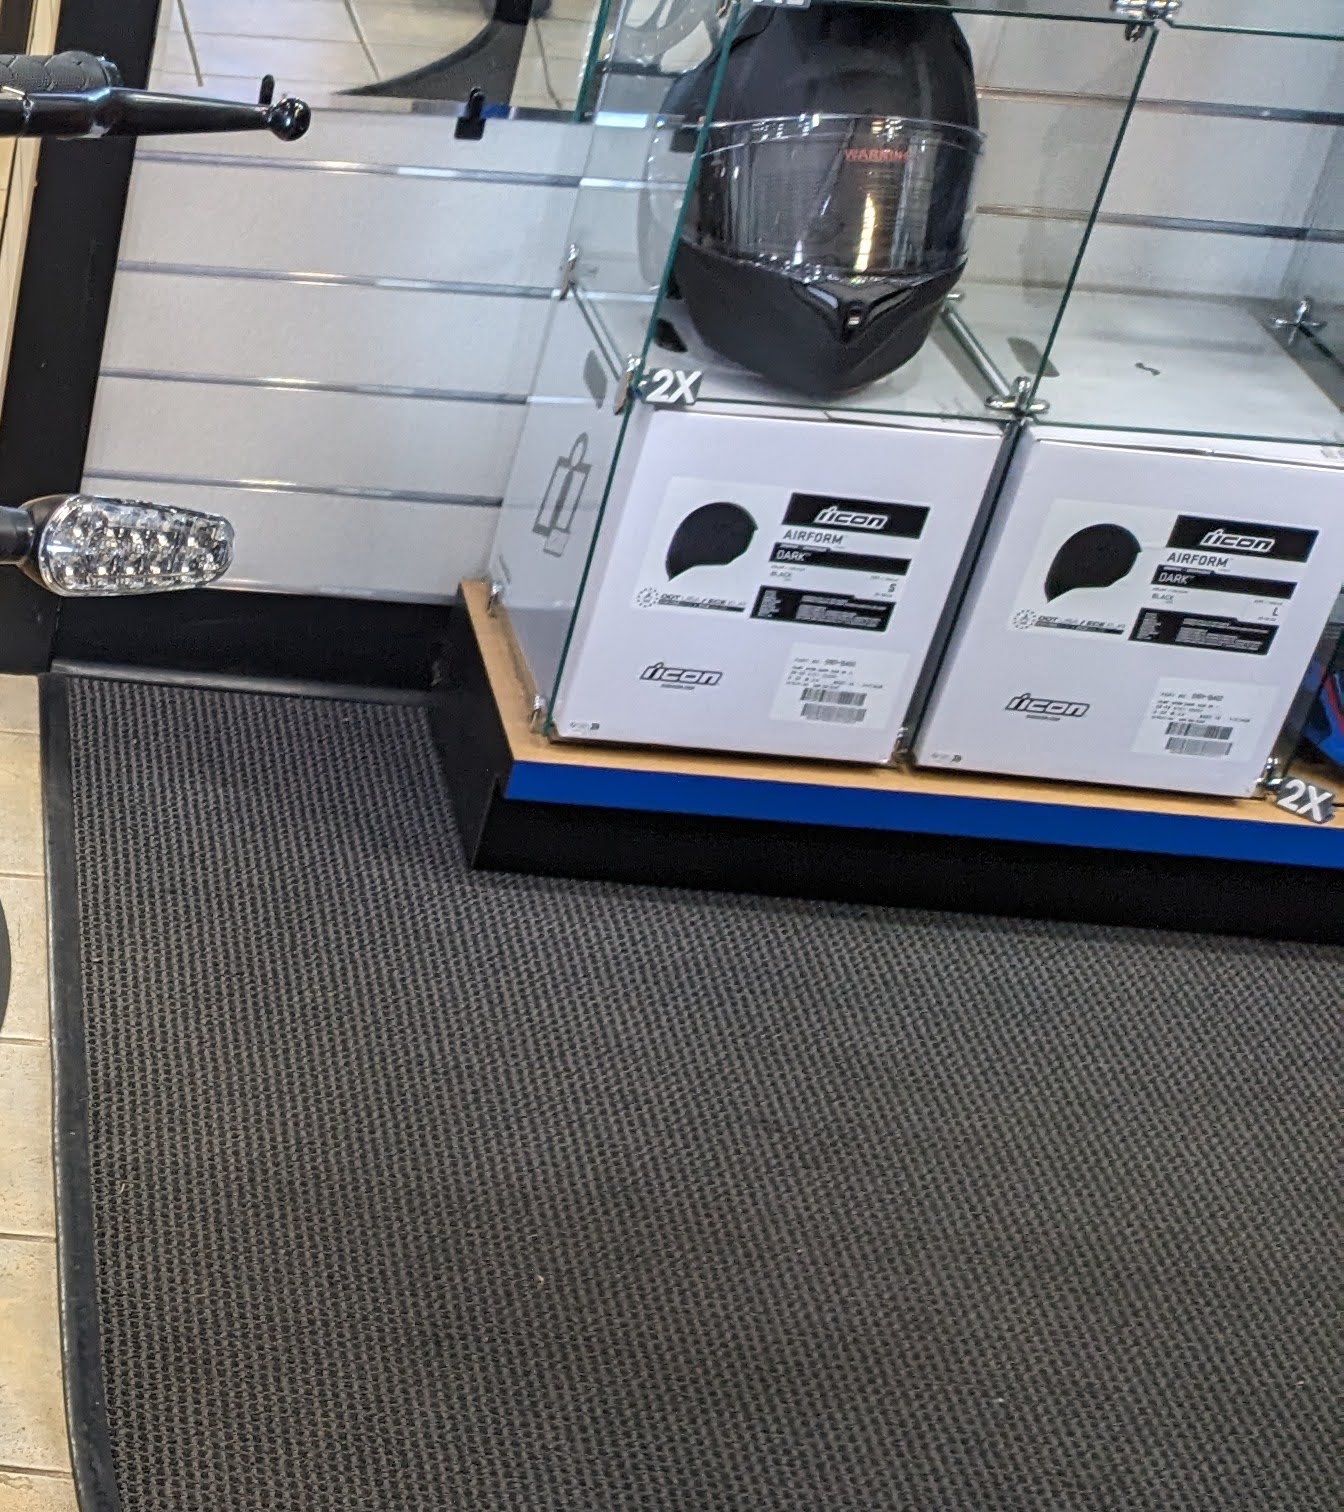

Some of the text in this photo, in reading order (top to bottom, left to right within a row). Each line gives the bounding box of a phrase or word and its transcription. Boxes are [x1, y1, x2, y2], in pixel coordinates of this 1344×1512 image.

[646, 368, 702, 403] 2X
[887, 582, 897, 593] S
[1272, 606, 1279, 617] L
[1277, 779, 1333, 822] 2X
